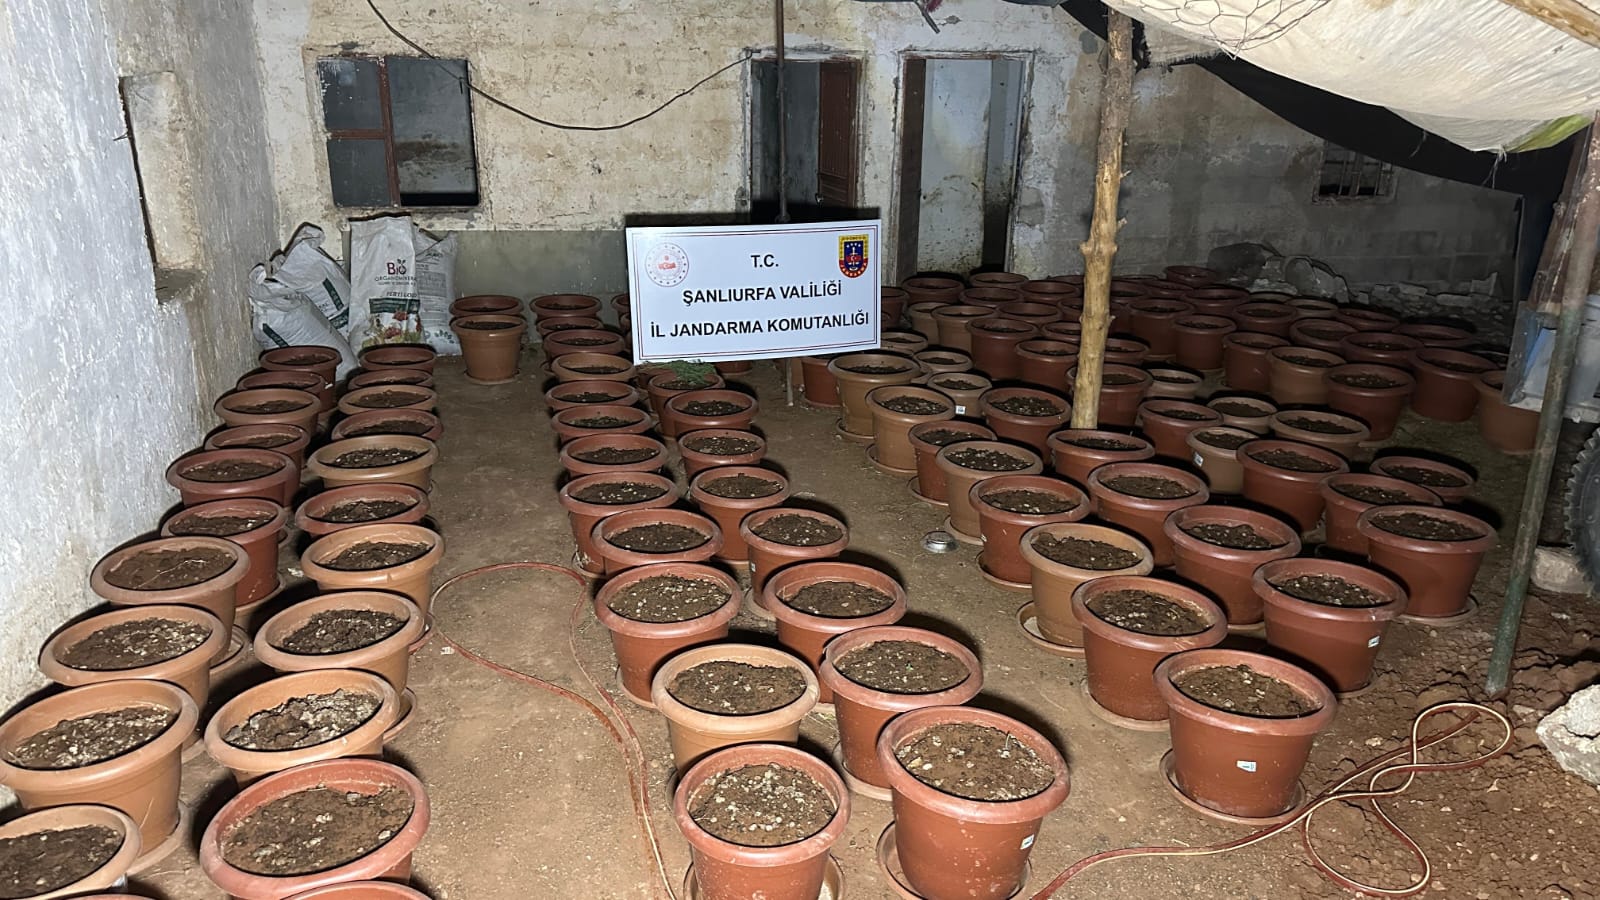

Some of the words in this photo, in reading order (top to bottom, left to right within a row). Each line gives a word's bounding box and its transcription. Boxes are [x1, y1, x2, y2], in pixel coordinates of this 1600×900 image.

[750, 254, 779, 268] T.C.
[683, 288, 776, 307] ŞANLIURFA
[779, 279, 842, 299] VALİLİĞİ
[650, 321, 666, 338] İL
[670, 320, 764, 337] JANDARMA
[767, 309, 869, 333] KOMUTANLIĞI
